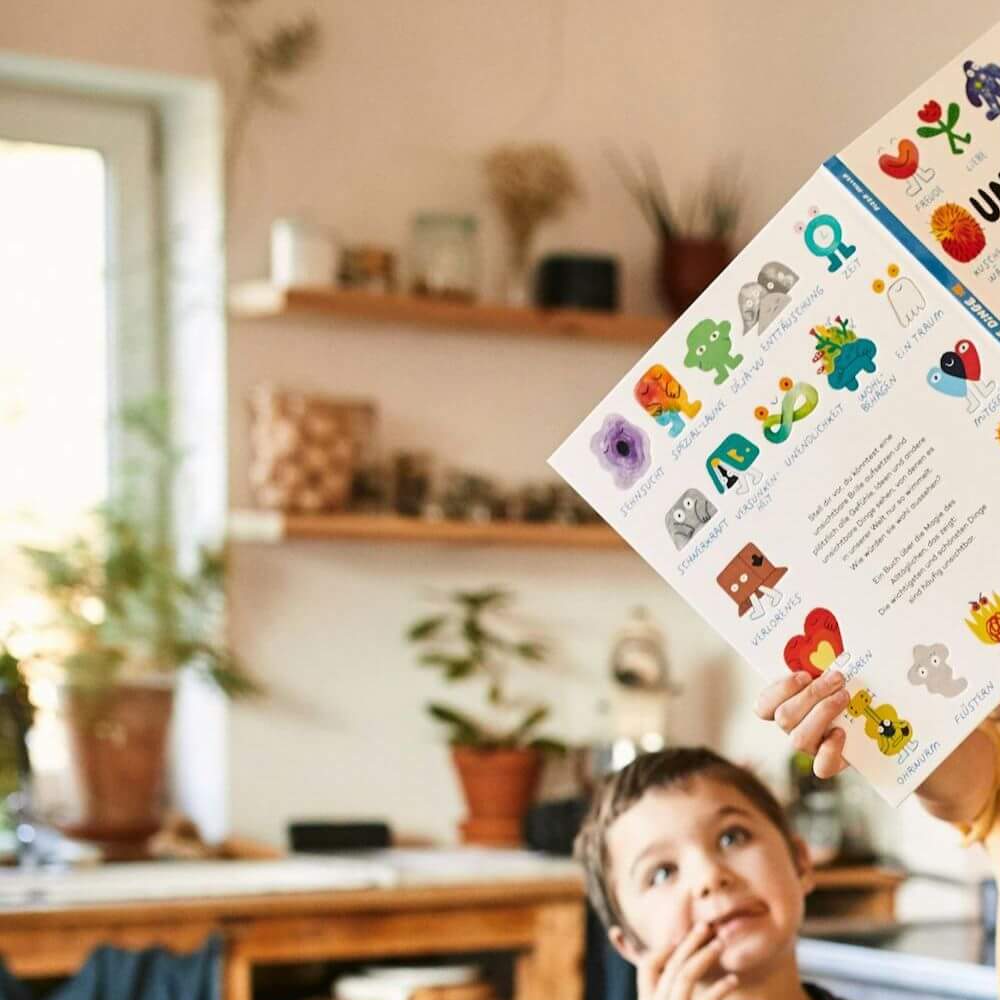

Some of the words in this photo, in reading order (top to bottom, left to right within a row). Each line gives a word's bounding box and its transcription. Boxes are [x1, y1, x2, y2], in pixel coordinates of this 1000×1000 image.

[859, 373, 898, 413] BEHAGEN
[617, 464, 669, 517] SEHNSUCHT
[806, 504, 824, 522] Stell
[820, 495, 833, 507] dir
[841, 474, 853, 486] du
[850, 446, 880, 477] könntest
[876, 431, 894, 449] eine
[810, 496, 849, 536] unsichtbare
[845, 480, 865, 500] Brille
[862, 448, 896, 483] aufsetzen
[891, 435, 908, 452] und
[819, 524, 859, 564] unsichtbare
[854, 505, 878, 529] Dinge
[904, 452, 927, 476] denen
[835, 514, 850, 529] alle
[872, 469, 893, 491] Ideen
[889, 457, 906, 473] und
[902, 435, 927, 460] andere
[847, 529, 872, 555] unserer
[869, 513, 887, 531] Welt
[848, 554, 865, 571] Wie
[861, 531, 887, 558] würden
[883, 522, 896, 535] sie
[893, 506, 911, 525] wohl
[871, 570, 885, 585] Ein
[881, 553, 901, 574] Buch
[897, 539, 915, 557] über
[911, 529, 925, 543] die
[922, 508, 946, 533] Magie
[940, 497, 956, 512] des
[876, 601, 891, 616] Die
[887, 565, 927, 606] wichtigsten
[922, 552, 939, 569] und
[934, 520, 969, 556] schönsten
[965, 501, 989, 525] Dinge
[924, 531, 940, 548] das
[906, 586, 923, 604] sind
[919, 566, 944, 592] häufig
[950, 678, 997, 726] FLÜSTERN
